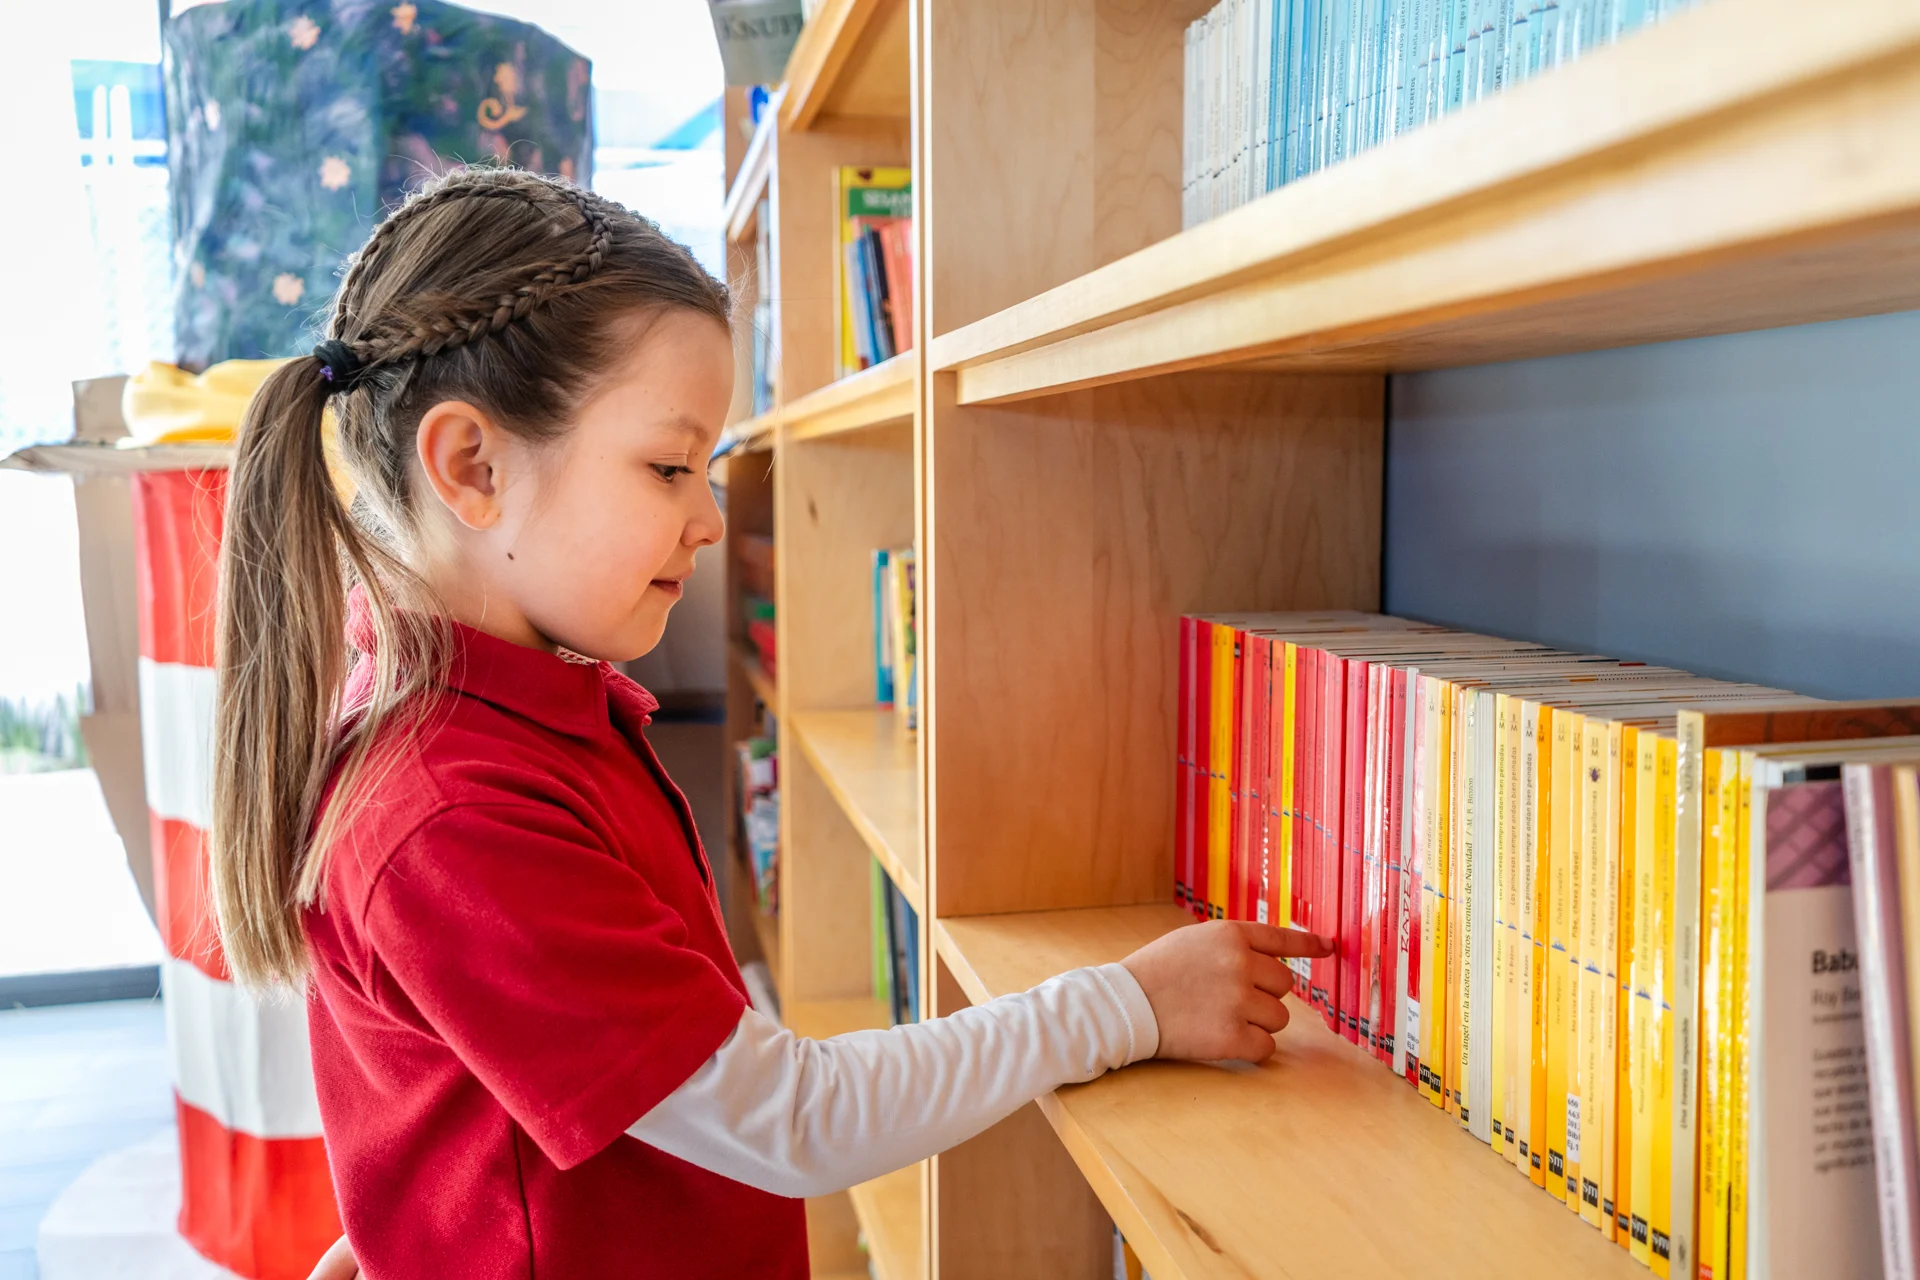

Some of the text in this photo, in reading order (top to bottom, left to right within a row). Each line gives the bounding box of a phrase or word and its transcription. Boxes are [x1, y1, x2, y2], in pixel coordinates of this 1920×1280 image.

[1497, 17, 1505, 52] TRIUNFO
[1411, 32, 1419, 57] MARÍA
[1408, 77, 1416, 126] DE SECRETOS
[1466, 817, 1473, 827] M.
[1465, 842, 1473, 881] Navidad
[1464, 883, 1472, 894] de
[1590, 888, 1597, 898] de
[1463, 1001, 1470, 1010] la
[1463, 1012, 1469, 1023] en
[1462, 1025, 1470, 1050] ángel
[1462, 1052, 1468, 1066] Un
